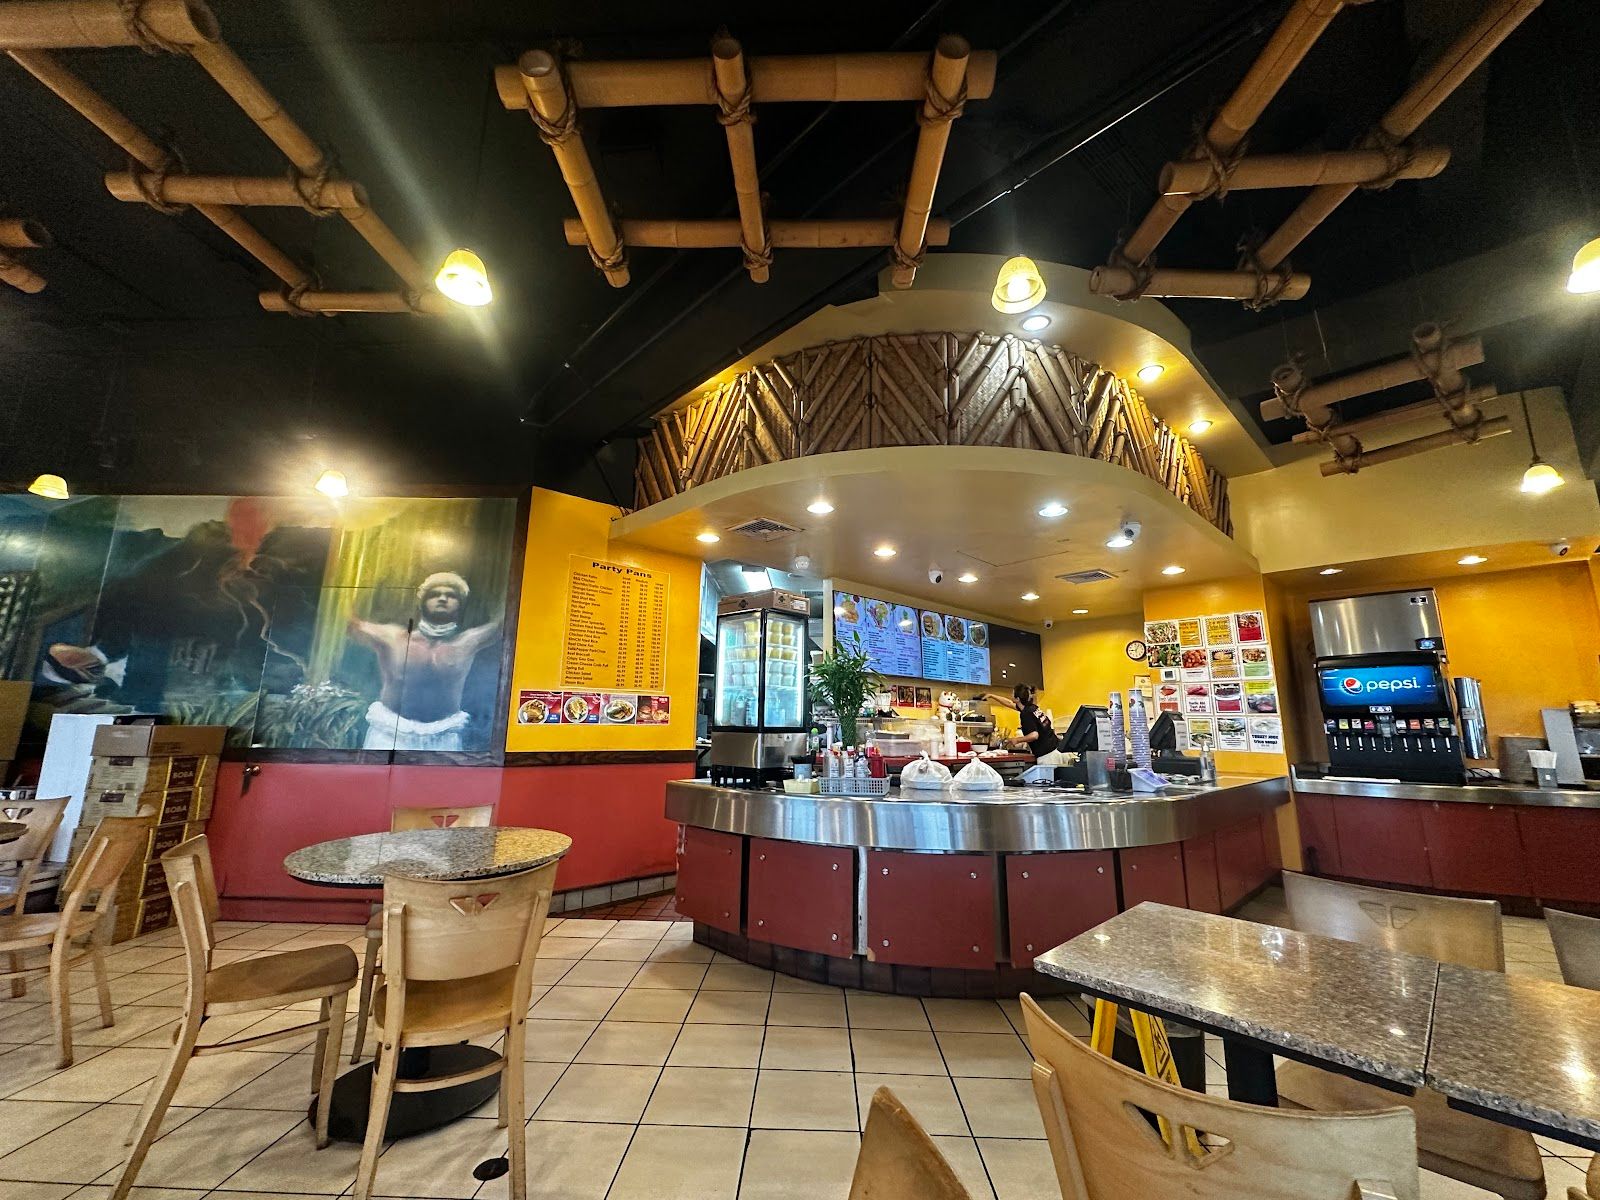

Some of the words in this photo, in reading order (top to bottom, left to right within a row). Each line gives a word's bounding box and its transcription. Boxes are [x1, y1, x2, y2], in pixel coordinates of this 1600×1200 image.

[592, 562, 622, 574] Party
[626, 568, 653, 578] Pans
[1366, 676, 1419, 694] pepsi
[165, 804, 187, 814] BOBA
